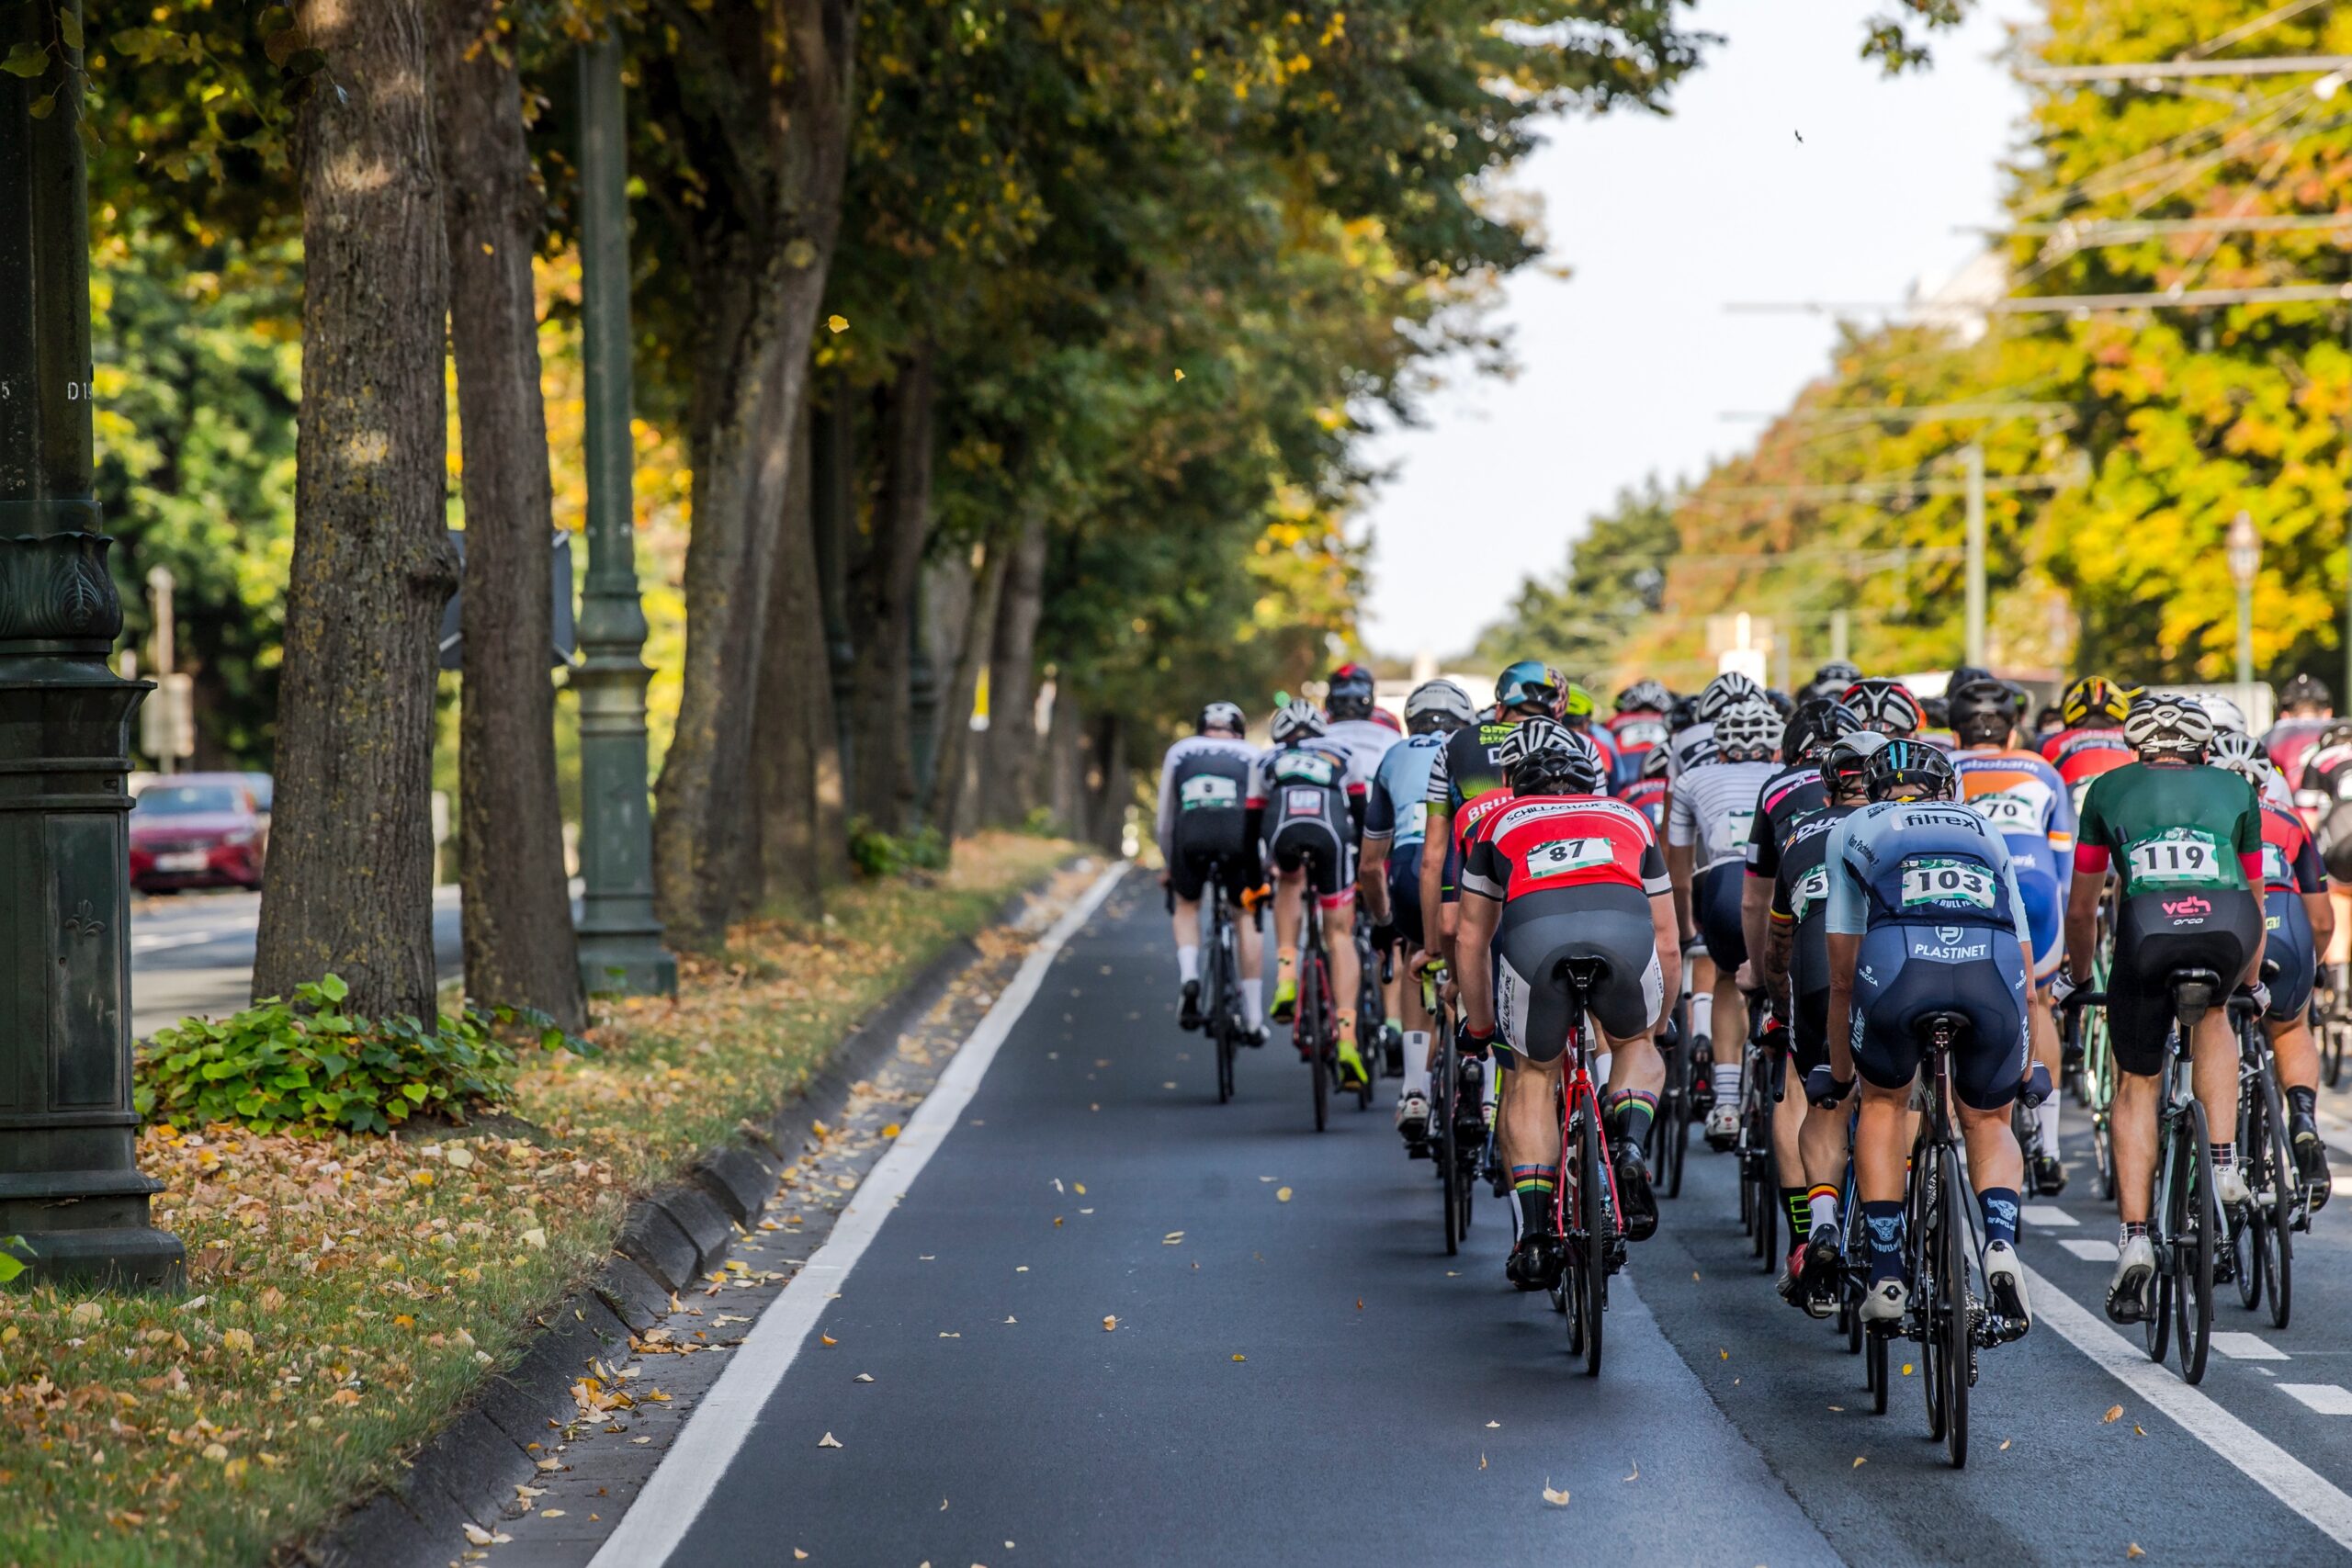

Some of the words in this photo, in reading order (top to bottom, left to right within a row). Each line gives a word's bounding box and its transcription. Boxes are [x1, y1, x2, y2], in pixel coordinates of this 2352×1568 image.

[1961, 760, 2040, 773] abobank
[1985, 803, 2018, 818] 70
[1549, 840, 1586, 862] 87
[2145, 845, 2205, 870] 119
[1917, 869, 1983, 895] 103
[2173, 918, 2204, 926] orca
[1915, 944, 1986, 960] PLASTINET
